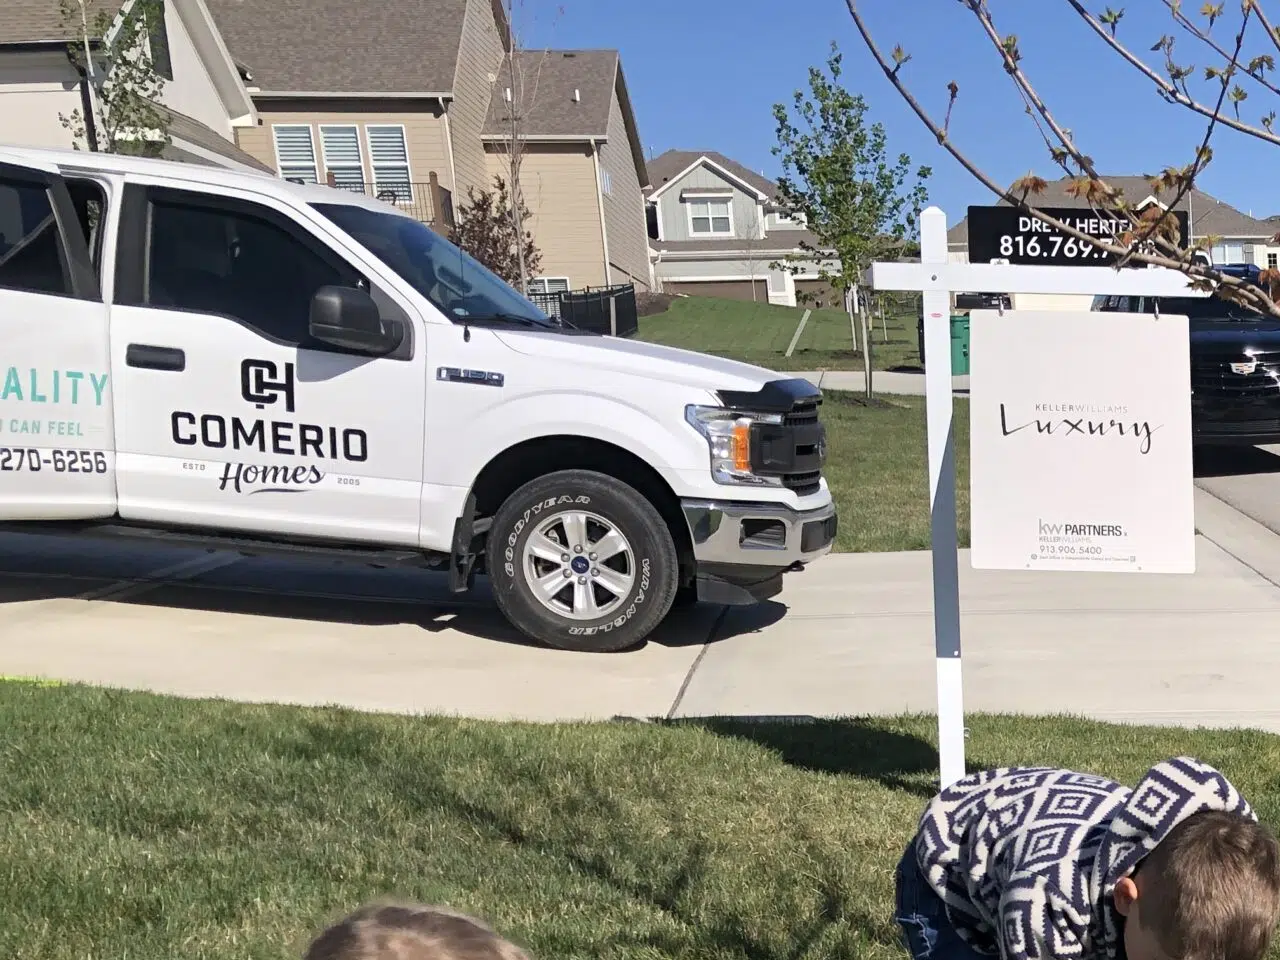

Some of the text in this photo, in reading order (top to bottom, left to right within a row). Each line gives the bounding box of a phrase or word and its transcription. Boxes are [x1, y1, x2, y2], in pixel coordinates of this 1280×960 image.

[10, 419, 40, 434] CAN
[48, 420, 84, 436] FEEL
[171, 410, 368, 462] COMERIO
[1000, 403, 1164, 454] Luxury
[0, 448, 107, 473] 270-6256
[182, 462, 206, 471] ESTD
[219, 462, 326, 494] Homes
[505, 495, 591, 577] GOODYEAR
[1065, 524, 1122, 536] PARTNERS
[568, 558, 650, 635] WRANGLER
